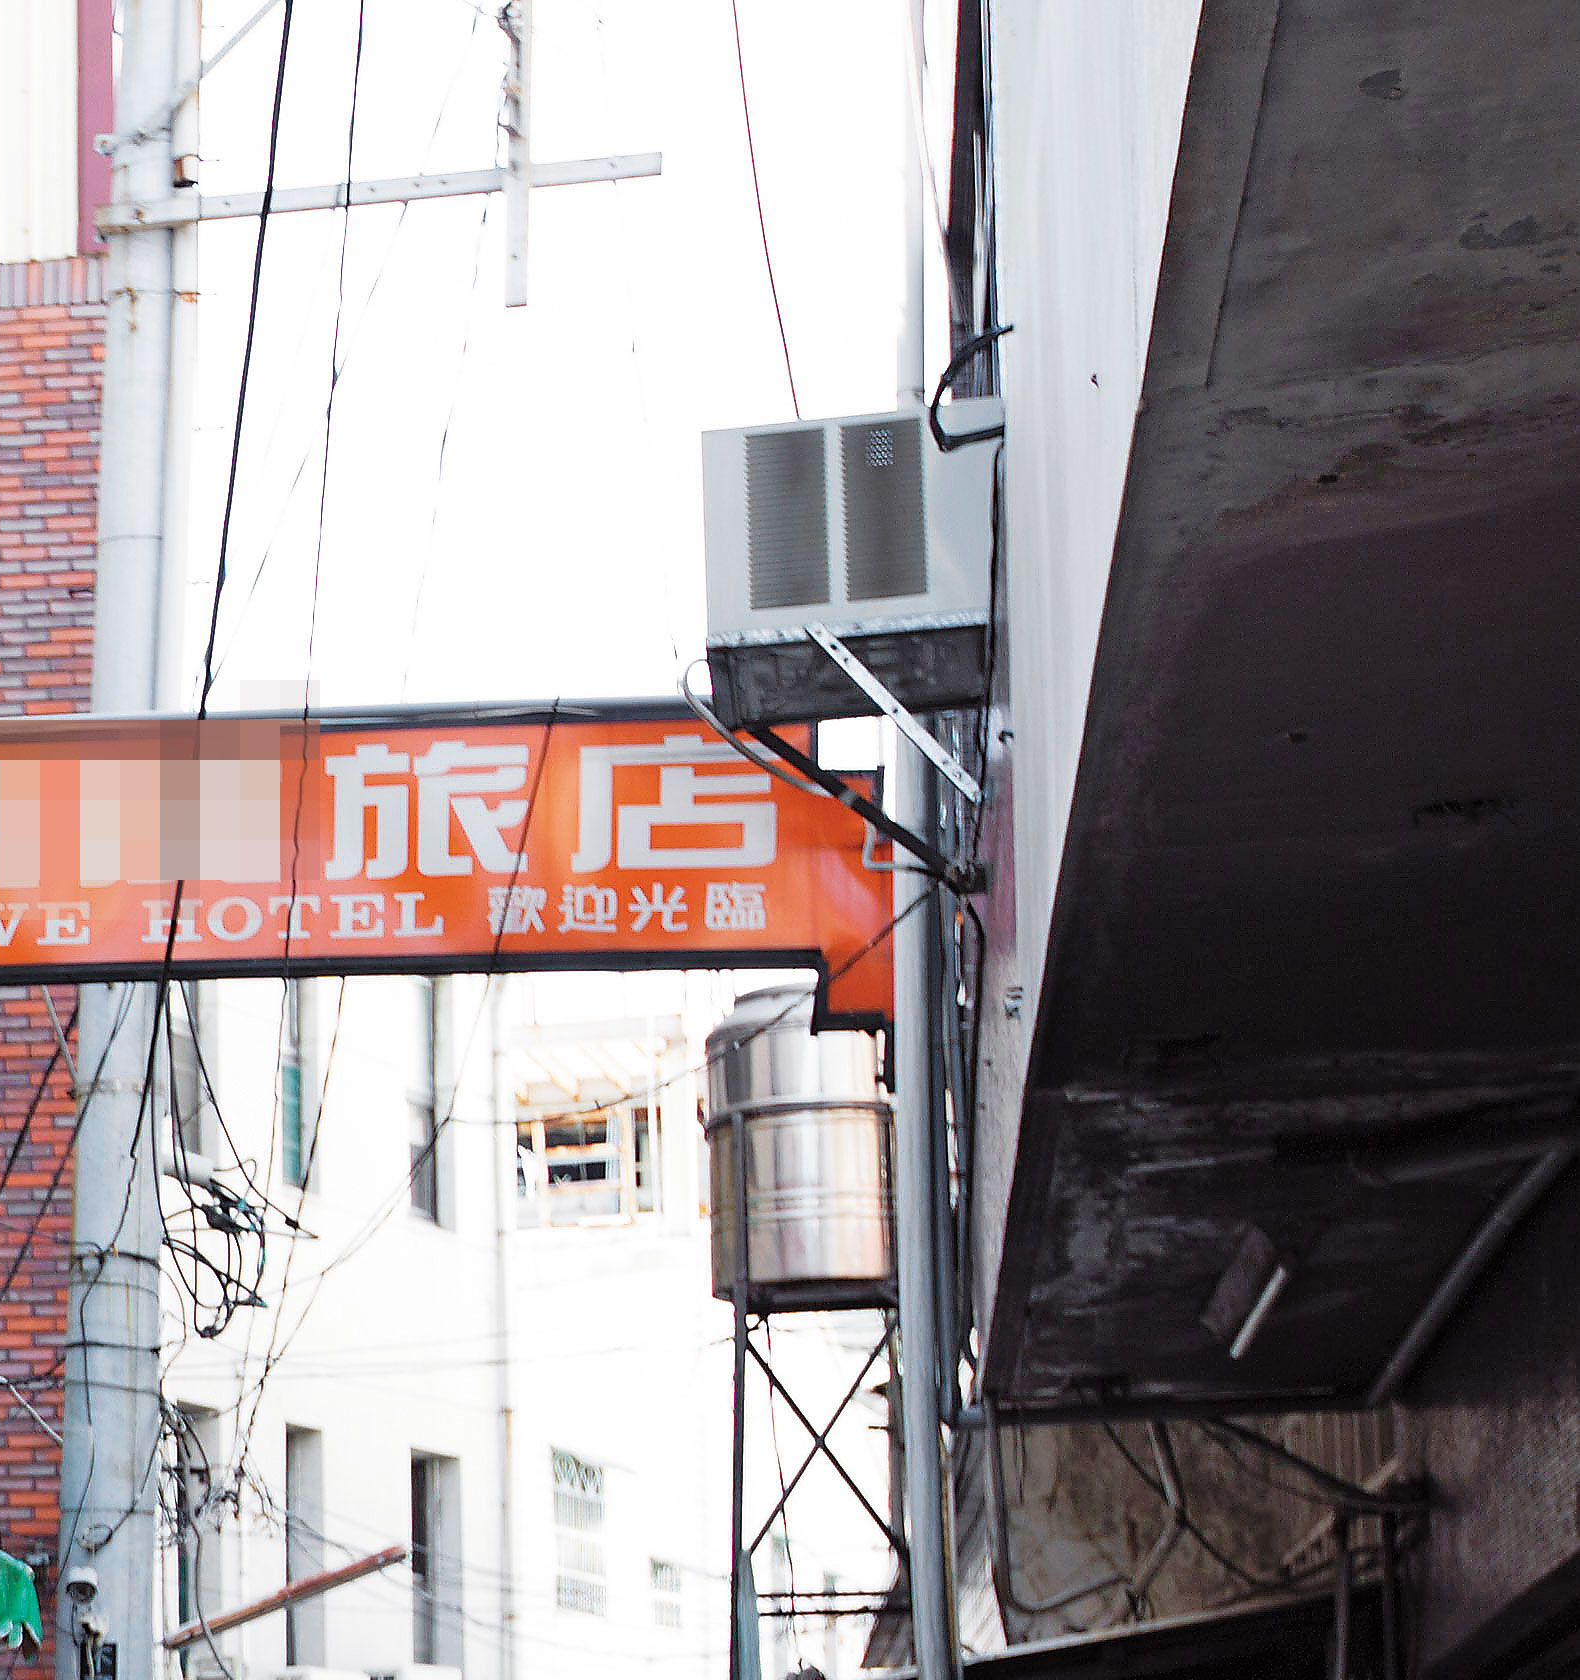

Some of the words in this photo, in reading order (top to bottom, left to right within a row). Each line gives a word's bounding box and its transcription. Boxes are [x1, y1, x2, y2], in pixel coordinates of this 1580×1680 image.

[324, 734, 785, 881] 旅店
[141, 891, 444, 944] HOTEL
[486, 880, 767, 935] 歡迎光臨
